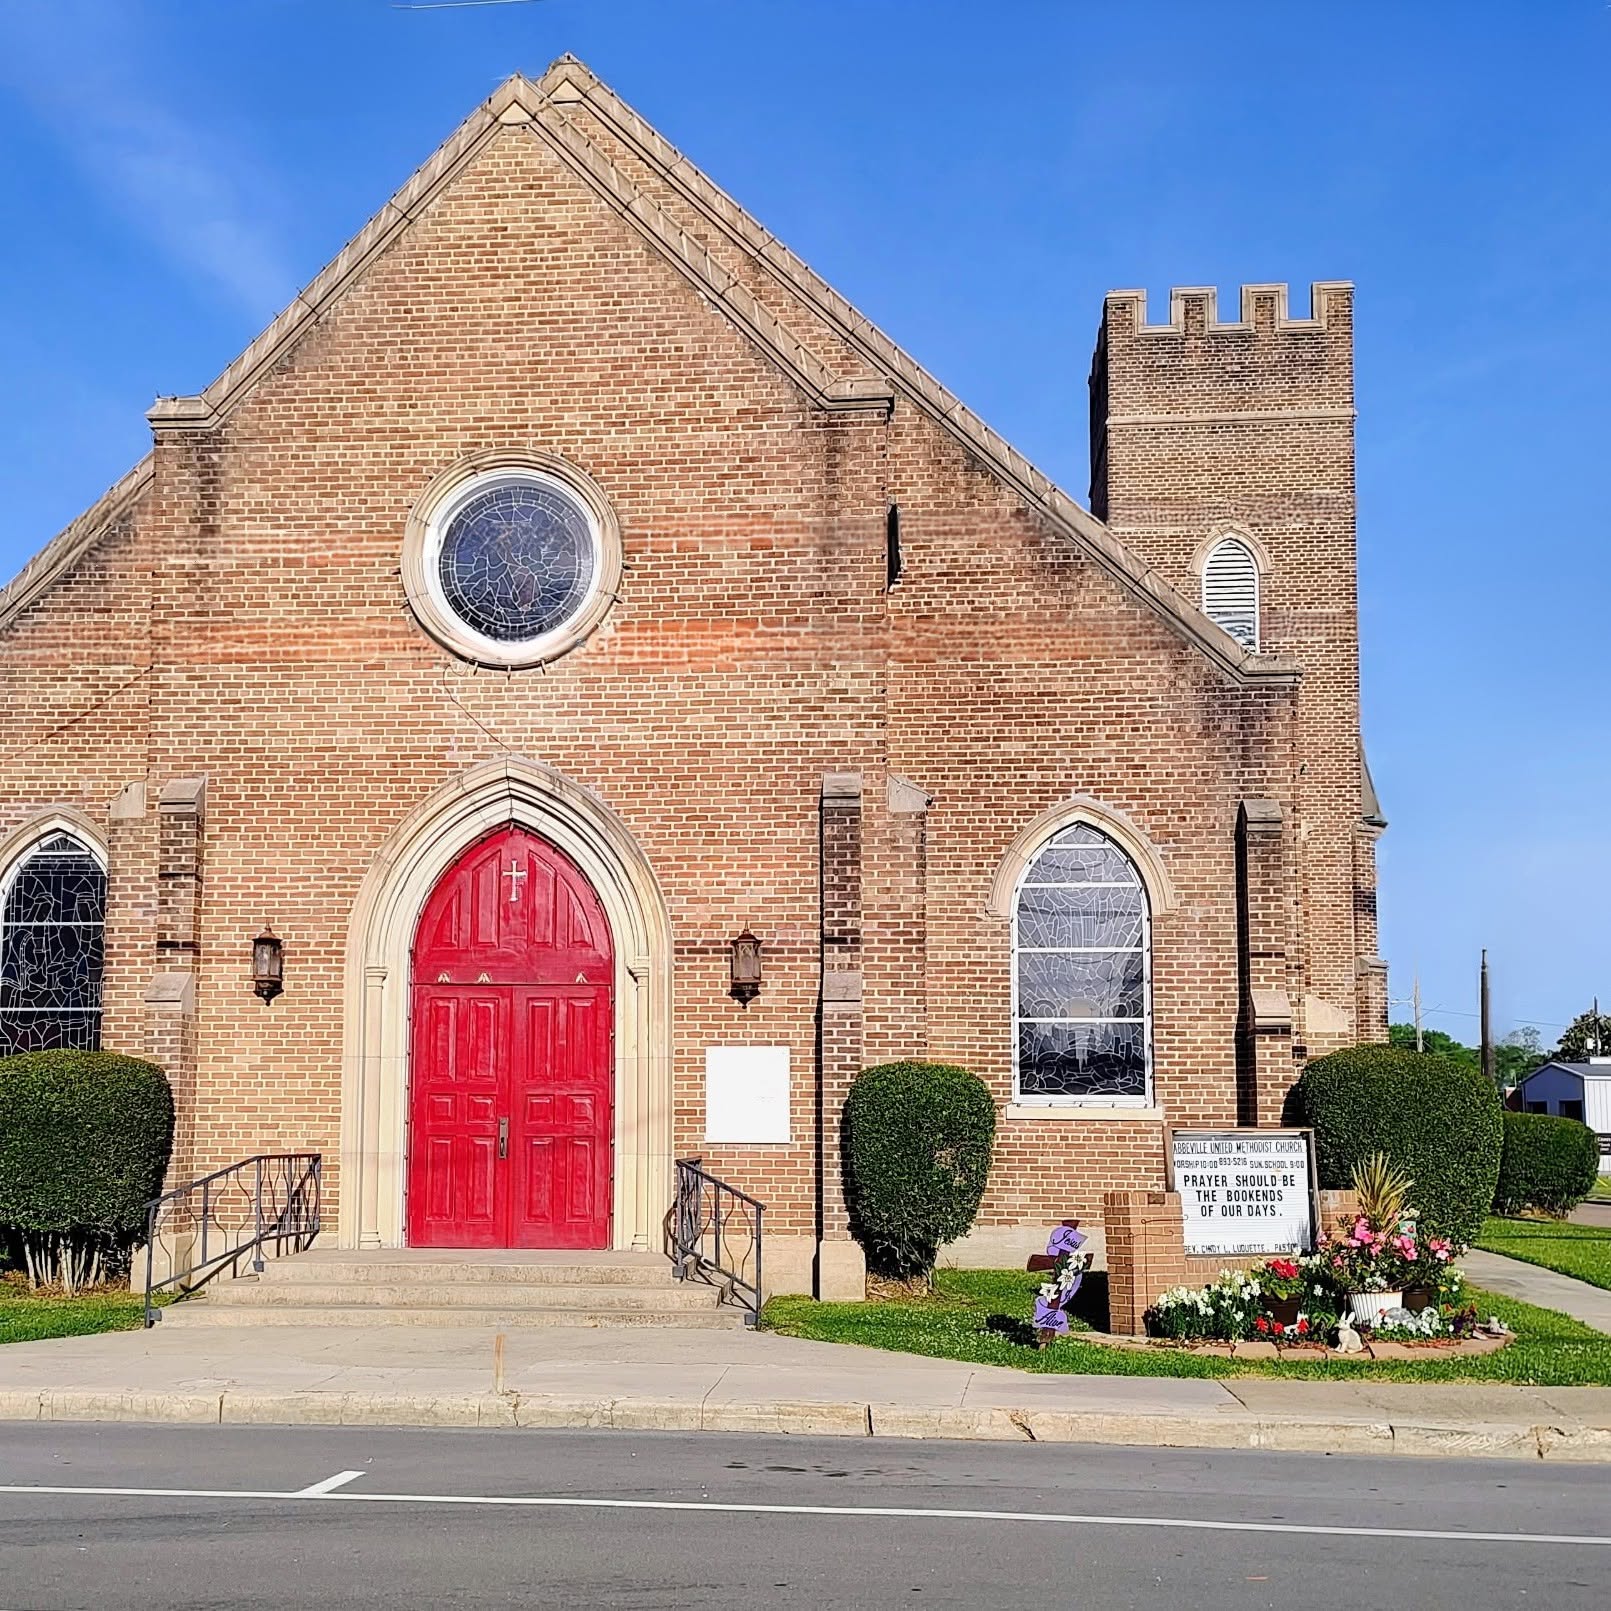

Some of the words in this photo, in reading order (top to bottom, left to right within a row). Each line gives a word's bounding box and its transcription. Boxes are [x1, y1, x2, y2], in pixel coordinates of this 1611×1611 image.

[1174, 1142, 1207, 1154] ABBEVILLE
[1210, 1142, 1233, 1154] UNITED
[1236, 1141, 1272, 1153] METHODIST
[1275, 1141, 1303, 1153] CHURCH
[1173, 1160, 1199, 1169] ORSHIP
[1183, 1174, 1228, 1187] PRAYER
[1235, 1174, 1276, 1187] SHOULD
[1282, 1174, 1296, 1187] BE
[1195, 1190, 1217, 1202] THE
[1226, 1190, 1283, 1202] BOOKENDS
[1200, 1205, 1214, 1217] OF
[1221, 1205, 1242, 1217] OUR
[1247, 1205, 1283, 1217] DAYS.
[1053, 1229, 1081, 1249] Jesus
[1035, 1310, 1064, 1328] Alive
